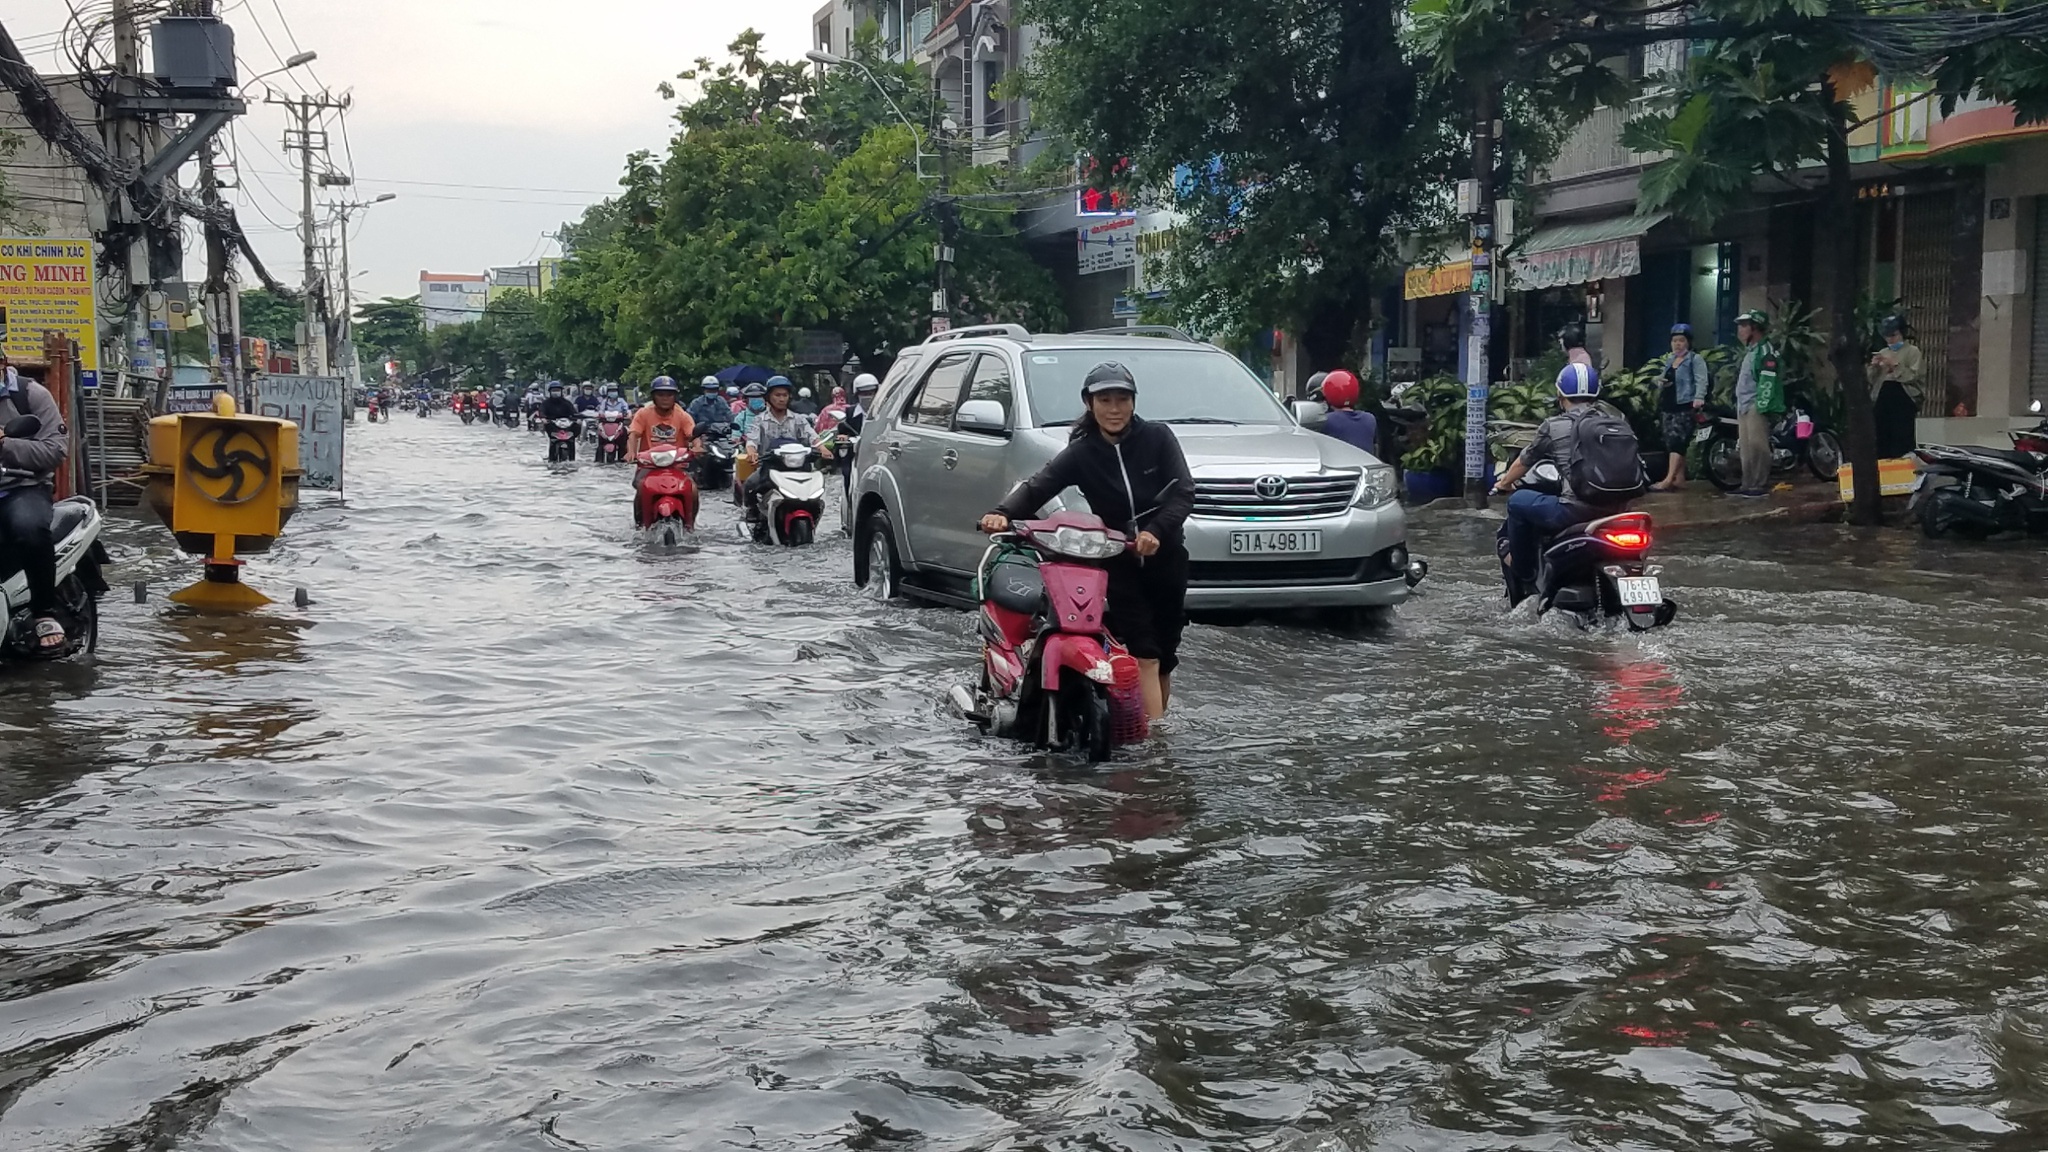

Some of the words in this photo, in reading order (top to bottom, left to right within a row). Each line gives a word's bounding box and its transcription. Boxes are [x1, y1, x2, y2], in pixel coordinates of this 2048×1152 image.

[33, 265, 87, 282] MINH
[1757, 381, 1773, 408] Grab
[1233, 532, 1317, 552] 51A-498.11
